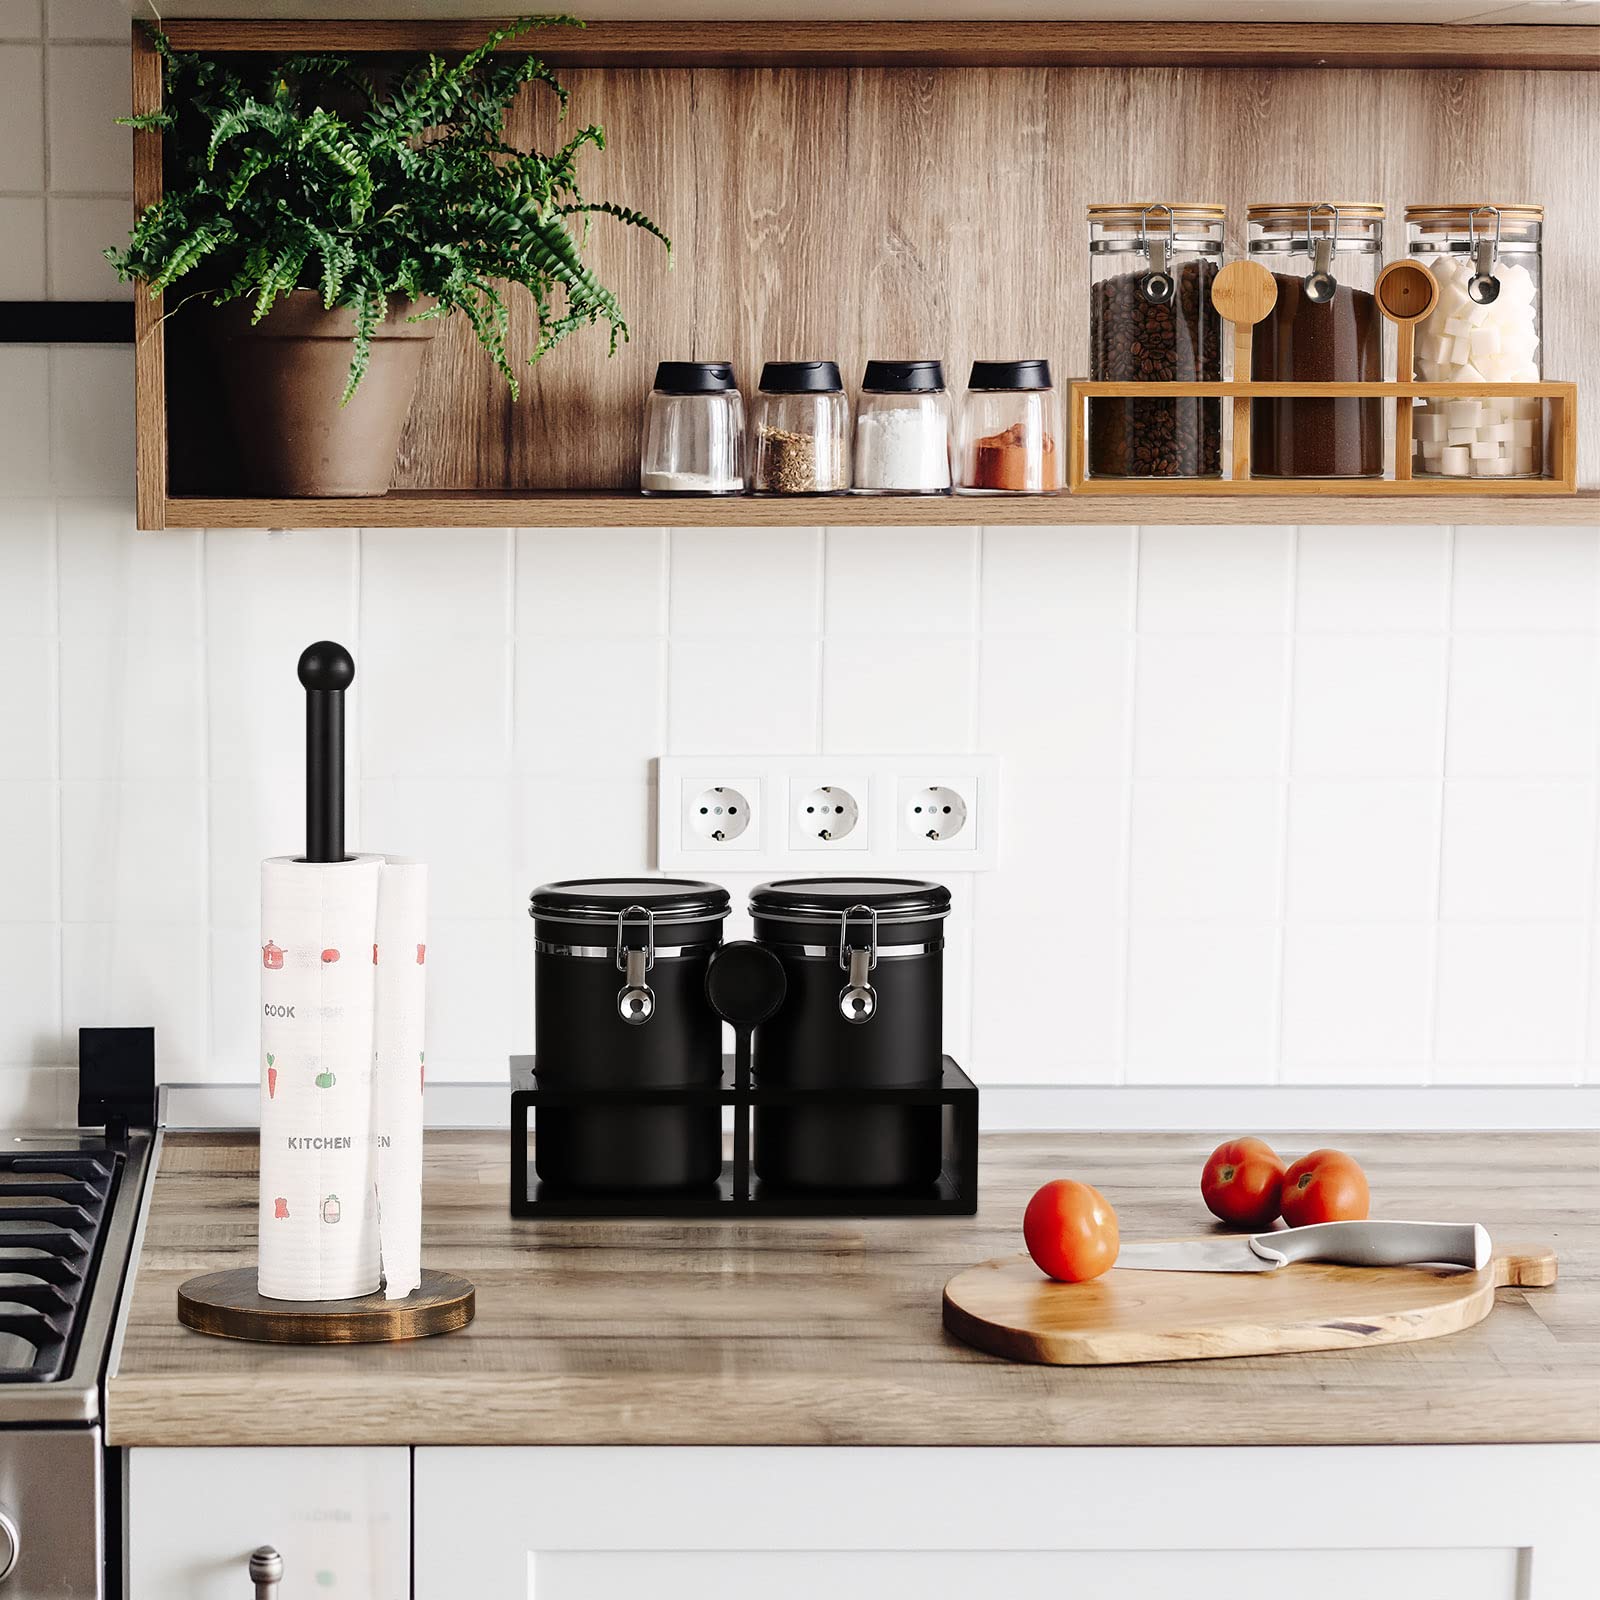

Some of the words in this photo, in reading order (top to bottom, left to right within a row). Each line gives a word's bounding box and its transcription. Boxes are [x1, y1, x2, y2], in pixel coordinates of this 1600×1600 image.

[264, 1003, 296, 1018] COOK
[287, 1137, 351, 1150] KITCHEN
[377, 1136, 391, 1148] N
